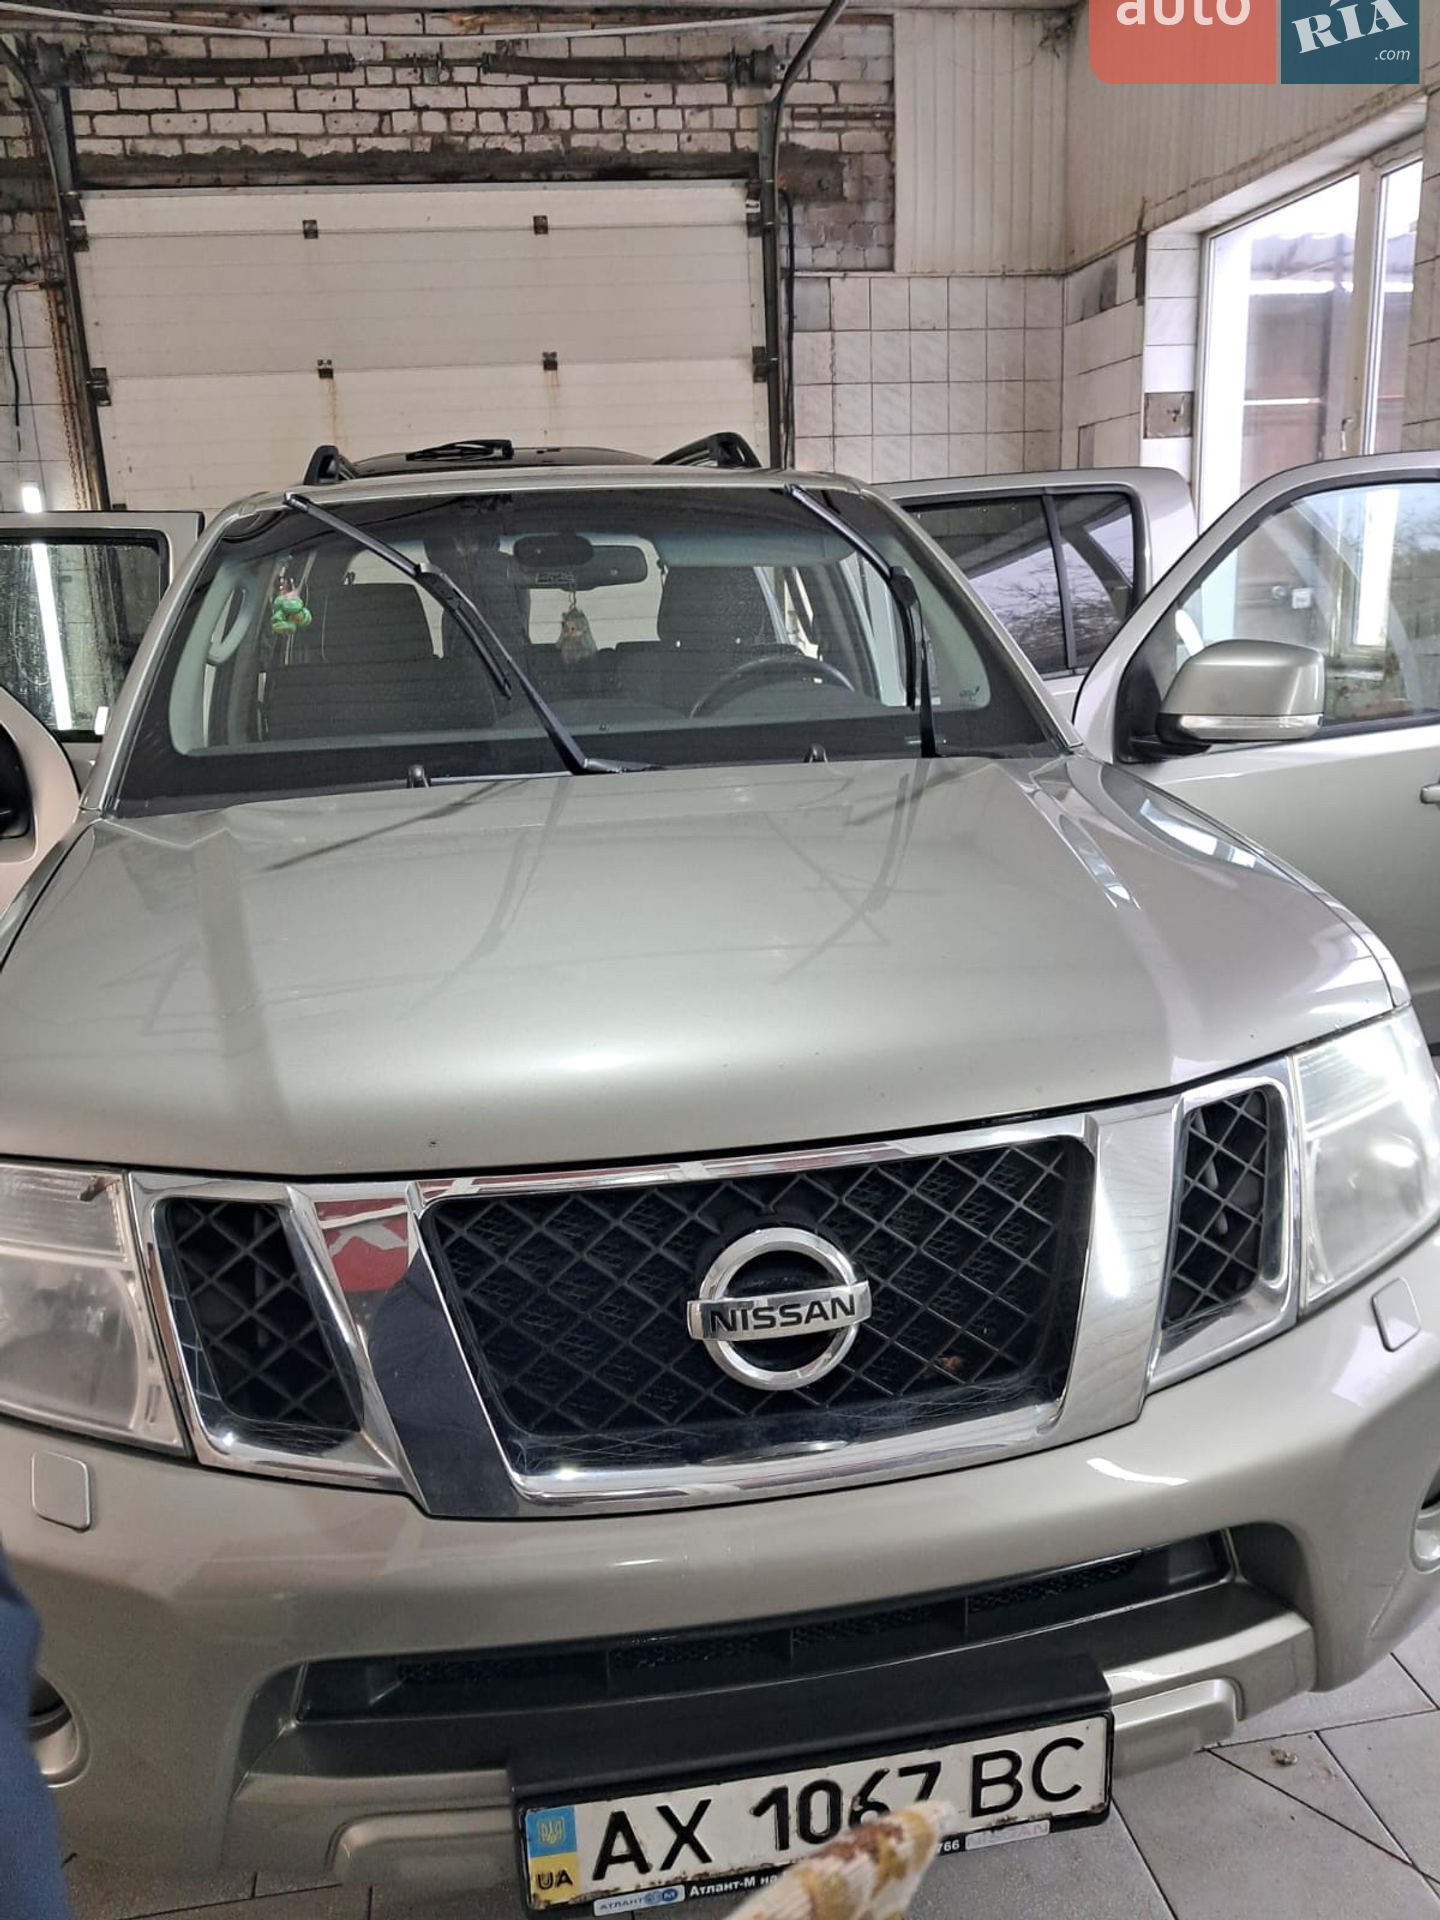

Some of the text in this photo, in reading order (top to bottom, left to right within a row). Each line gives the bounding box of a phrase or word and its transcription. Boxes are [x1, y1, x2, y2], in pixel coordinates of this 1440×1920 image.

[710, 1294, 856, 1333] NISSAN
[592, 1737, 1085, 1881] AX 1067 BC
[537, 1869, 574, 1890] UA
[689, 1877, 756, 1897] Атлант-М
